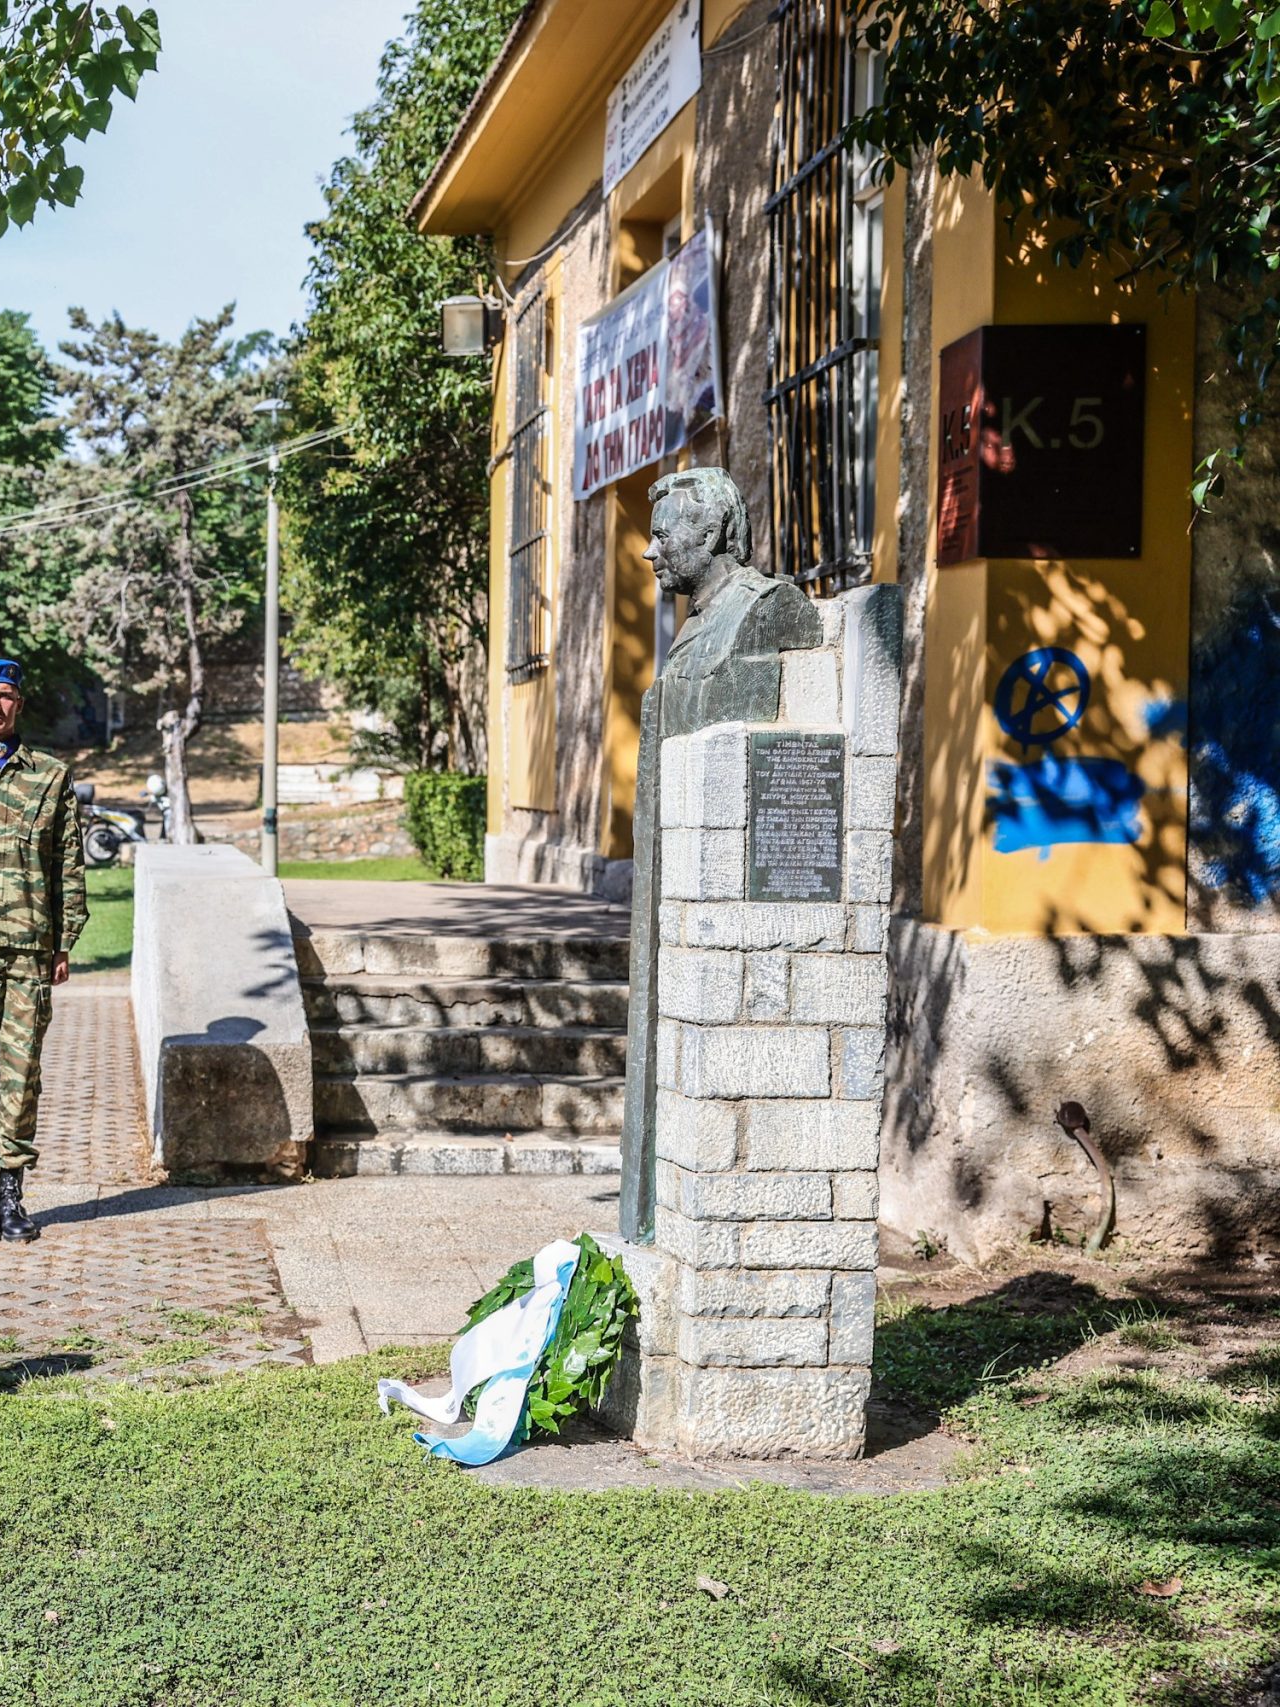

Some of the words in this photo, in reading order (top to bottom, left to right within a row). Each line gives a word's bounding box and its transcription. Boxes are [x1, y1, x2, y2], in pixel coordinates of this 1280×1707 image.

[610, 365, 623, 414] ΤΑ
[626, 341, 659, 405] ΧΕΡΙΑ
[603, 426, 625, 479] ΤΗΝ
[628, 404, 665, 468] ΓΥΑΡΟ
